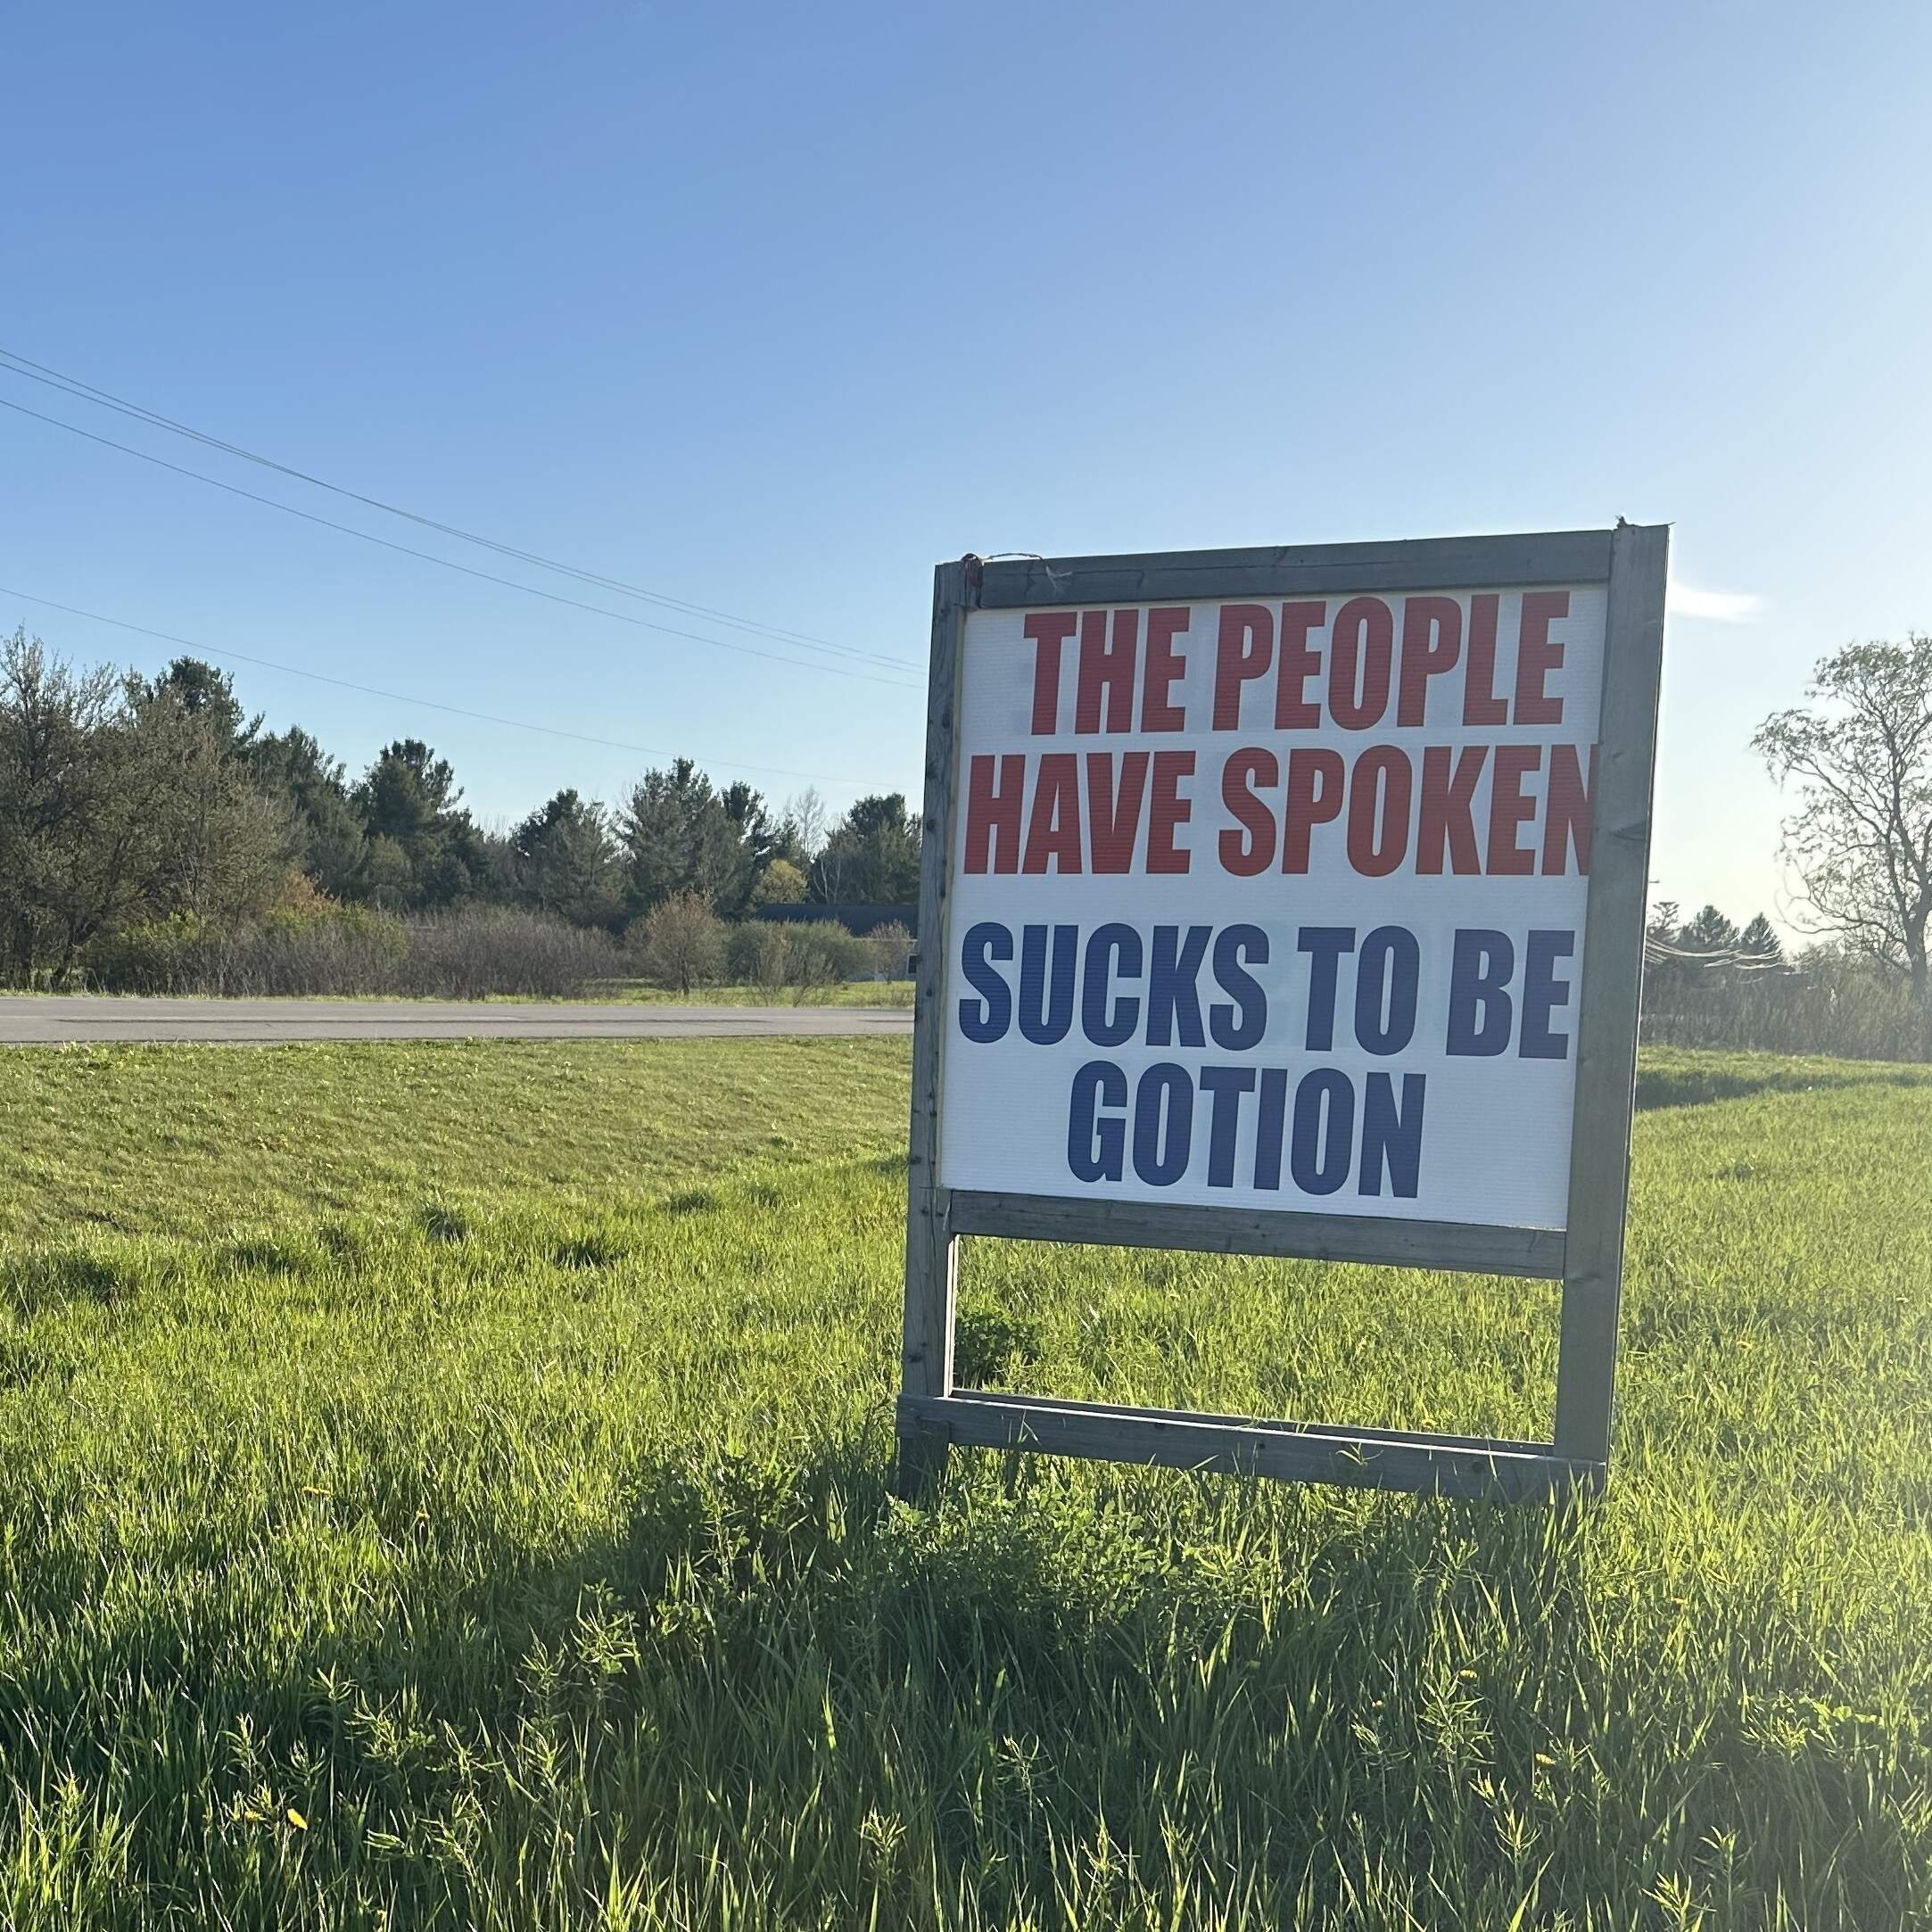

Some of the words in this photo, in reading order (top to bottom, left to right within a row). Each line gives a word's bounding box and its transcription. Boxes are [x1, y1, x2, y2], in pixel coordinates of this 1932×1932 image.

[1024, 607, 1191, 735] THE
[1211, 590, 1570, 731] PEOPLE
[963, 750, 1196, 875] HAVE
[1218, 743, 1599, 877] SPOKEN
[959, 922, 1269, 1052] SUCKS
[1297, 926, 1420, 1055] TO
[1446, 929, 1575, 1060] BE
[1068, 1061, 1426, 1199] GOTION
